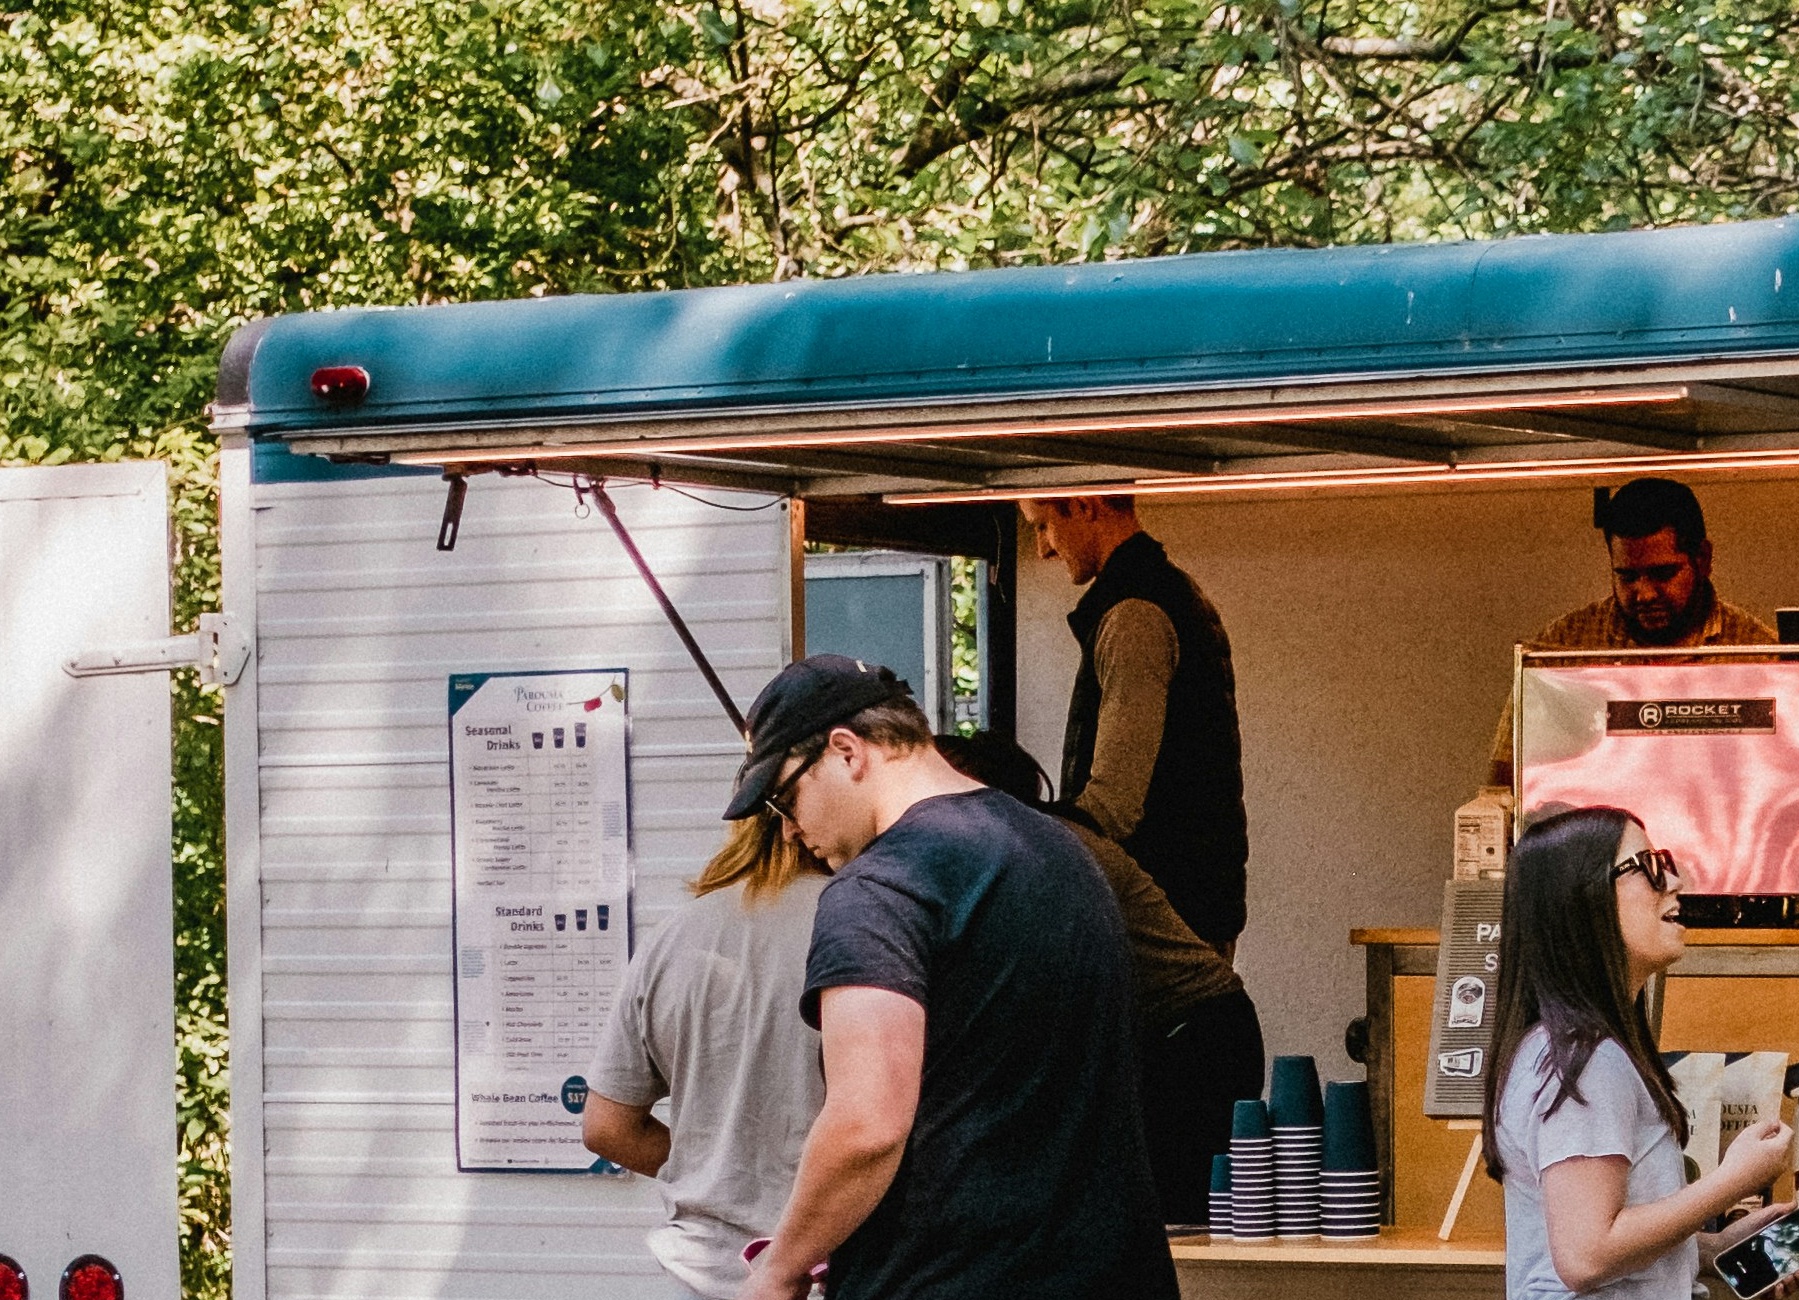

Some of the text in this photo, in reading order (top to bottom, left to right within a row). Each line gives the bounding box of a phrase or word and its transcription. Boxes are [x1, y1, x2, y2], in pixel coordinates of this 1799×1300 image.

[1665, 704, 1743, 715] ROCKET
[465, 725, 512, 735] Seasonal
[486, 740, 521, 750] Drinks
[495, 905, 543, 916] Standard
[510, 920, 545, 931] Drinks
[472, 1092, 559, 1103] Whole Bean Coffee
